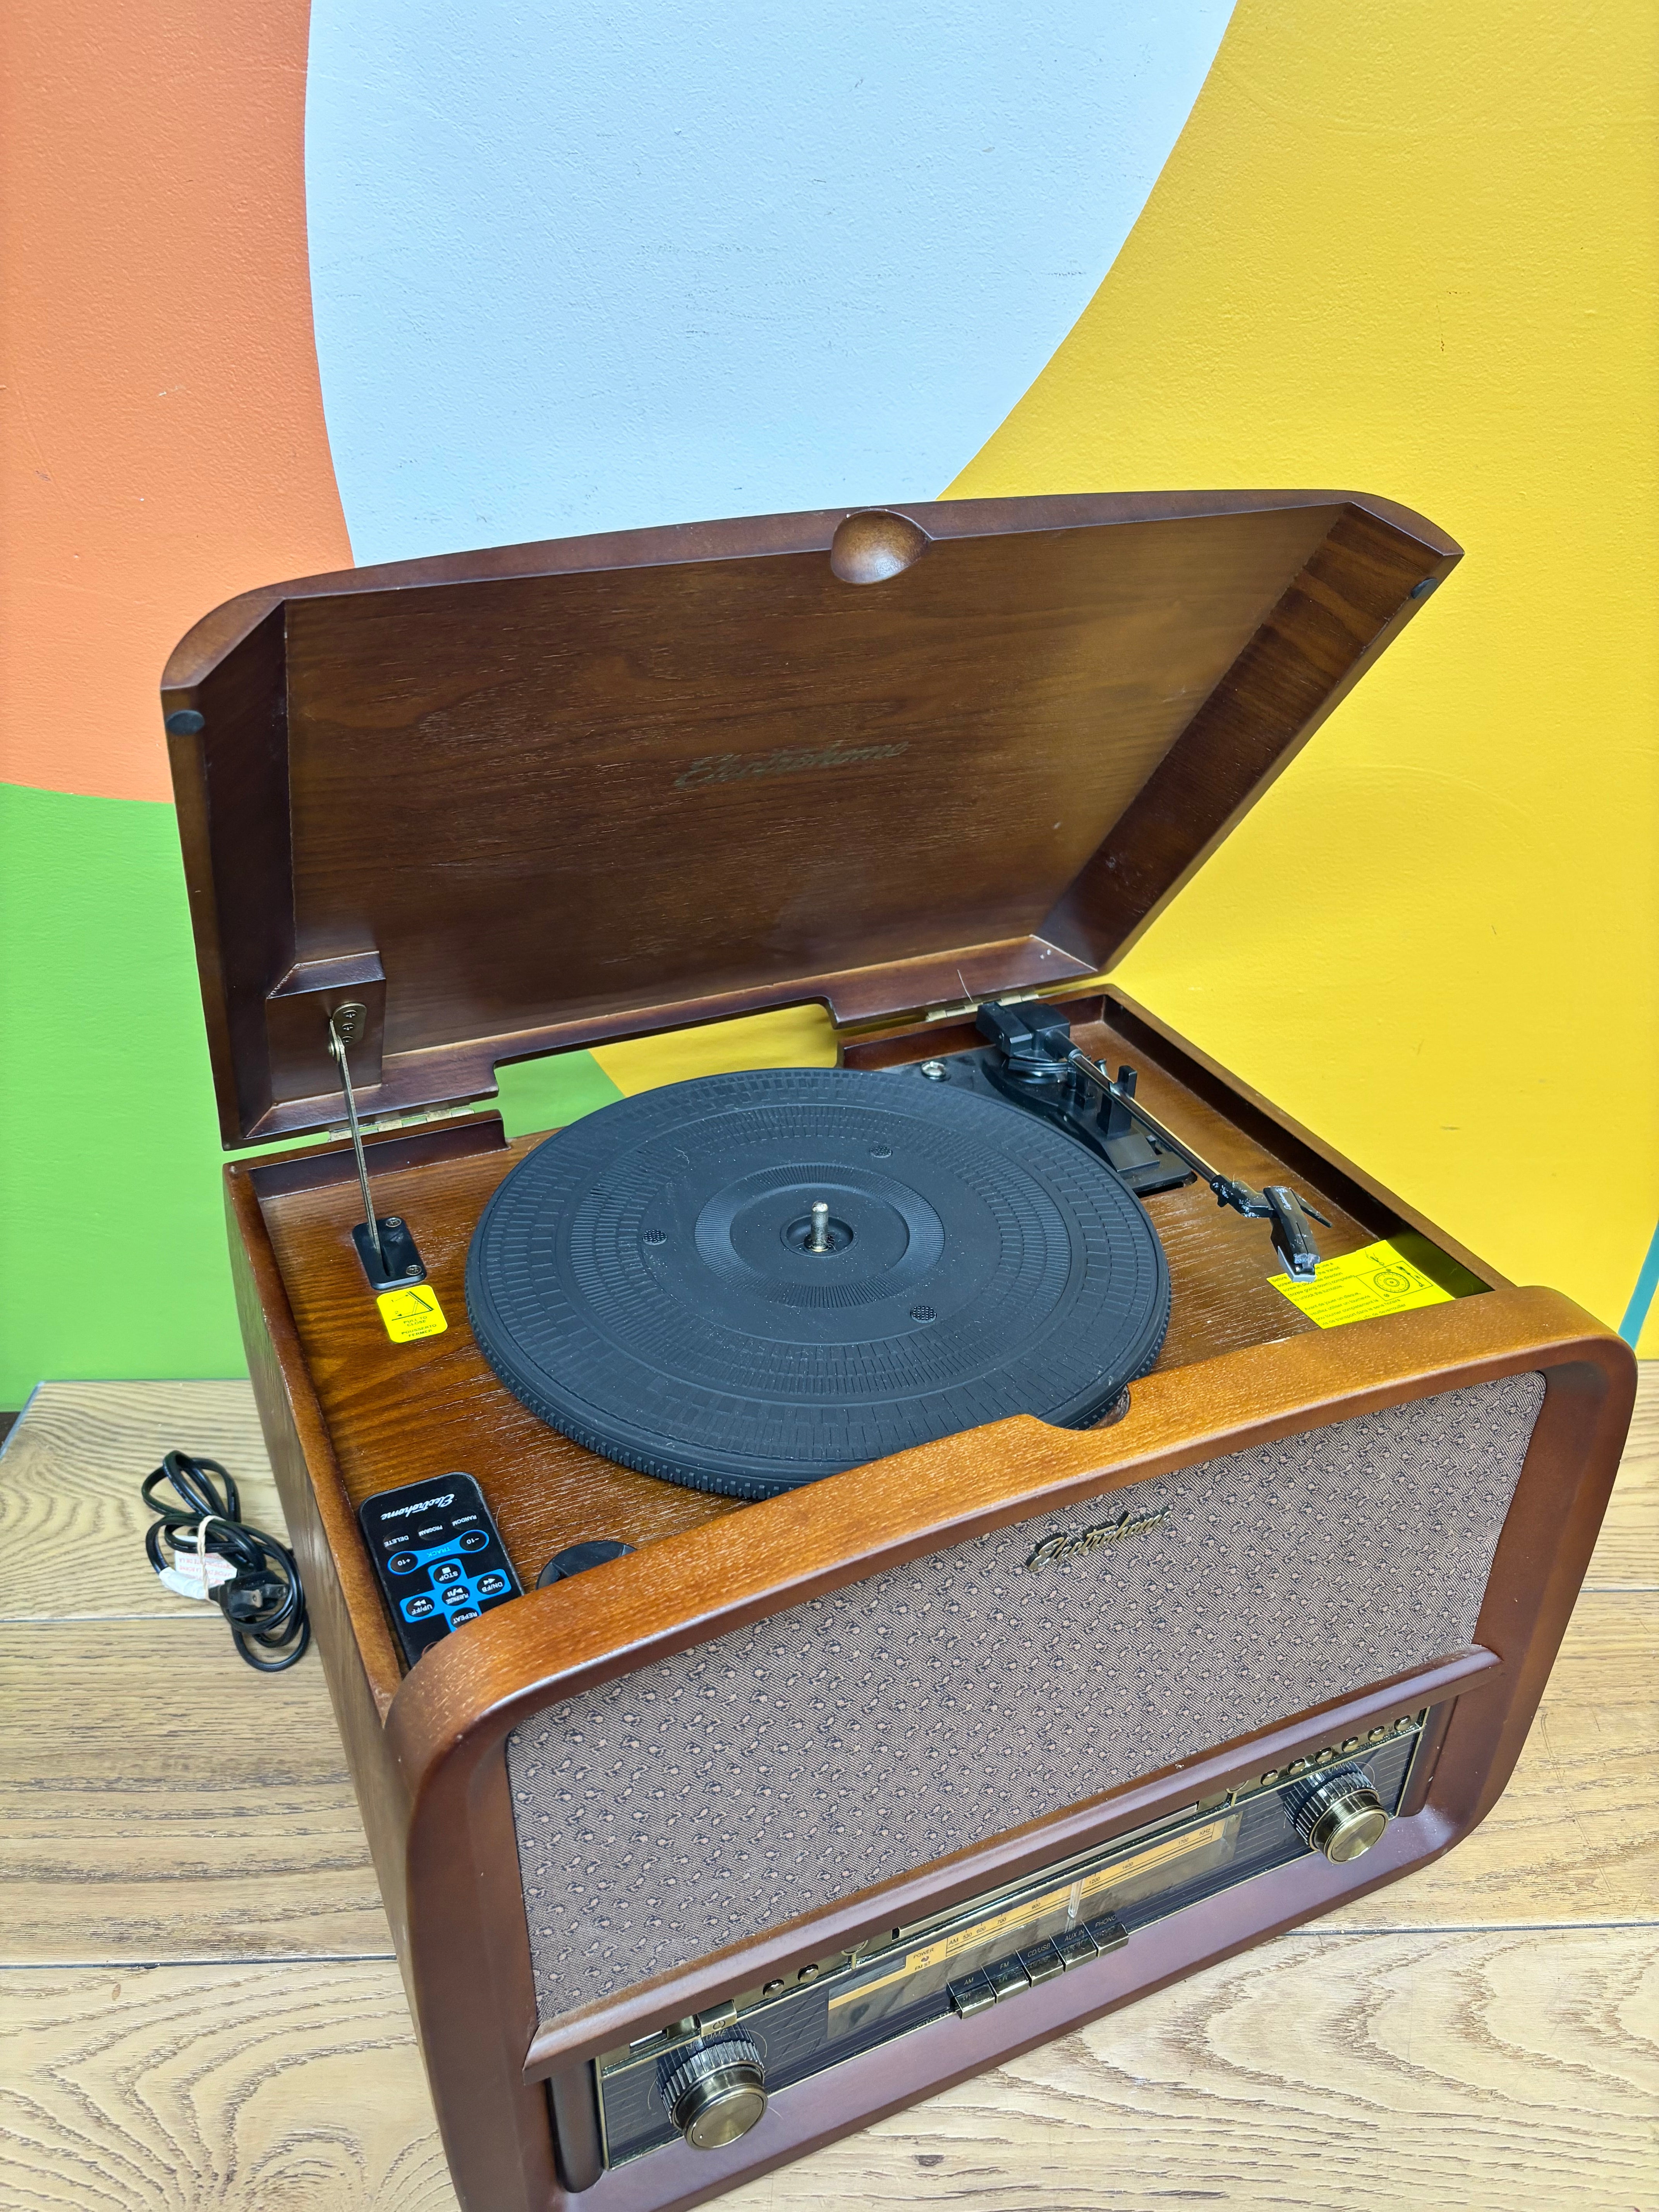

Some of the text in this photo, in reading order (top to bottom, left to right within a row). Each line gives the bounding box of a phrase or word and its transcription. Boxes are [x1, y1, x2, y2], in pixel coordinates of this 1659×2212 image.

[380, 1493, 455, 1520] Electrohome
[452, 1515, 477, 1526] RANDOM
[418, 1525, 443, 1536] PROGRAM
[384, 1535, 409, 1547] DELETE
[1029, 1510, 1172, 1570] Electrohome
[427, 1547, 451, 1558] TRACK
[439, 1571, 459, 1582] STOP
[481, 1582, 503, 1592] DN/FB
[445, 1593, 469, 1604] PLAY/PAUSE
[411, 1604, 433, 1615] UP/FF
[453, 1611, 478, 1624] REPEAT
[1199, 1828, 1211, 1836] KHz
[1089, 1877, 1101, 1885] 1200
[1095, 1914, 1117, 1927] PHONO
[1065, 1928, 1085, 1942] AUX IN
[948, 1937, 958, 1946] AM
[914, 1948, 934, 1959] POWER
[1027, 1942, 1051, 1958] CD/USB
[1000, 1961, 1009, 1969] FM
[964, 1977, 974, 1985] AM
